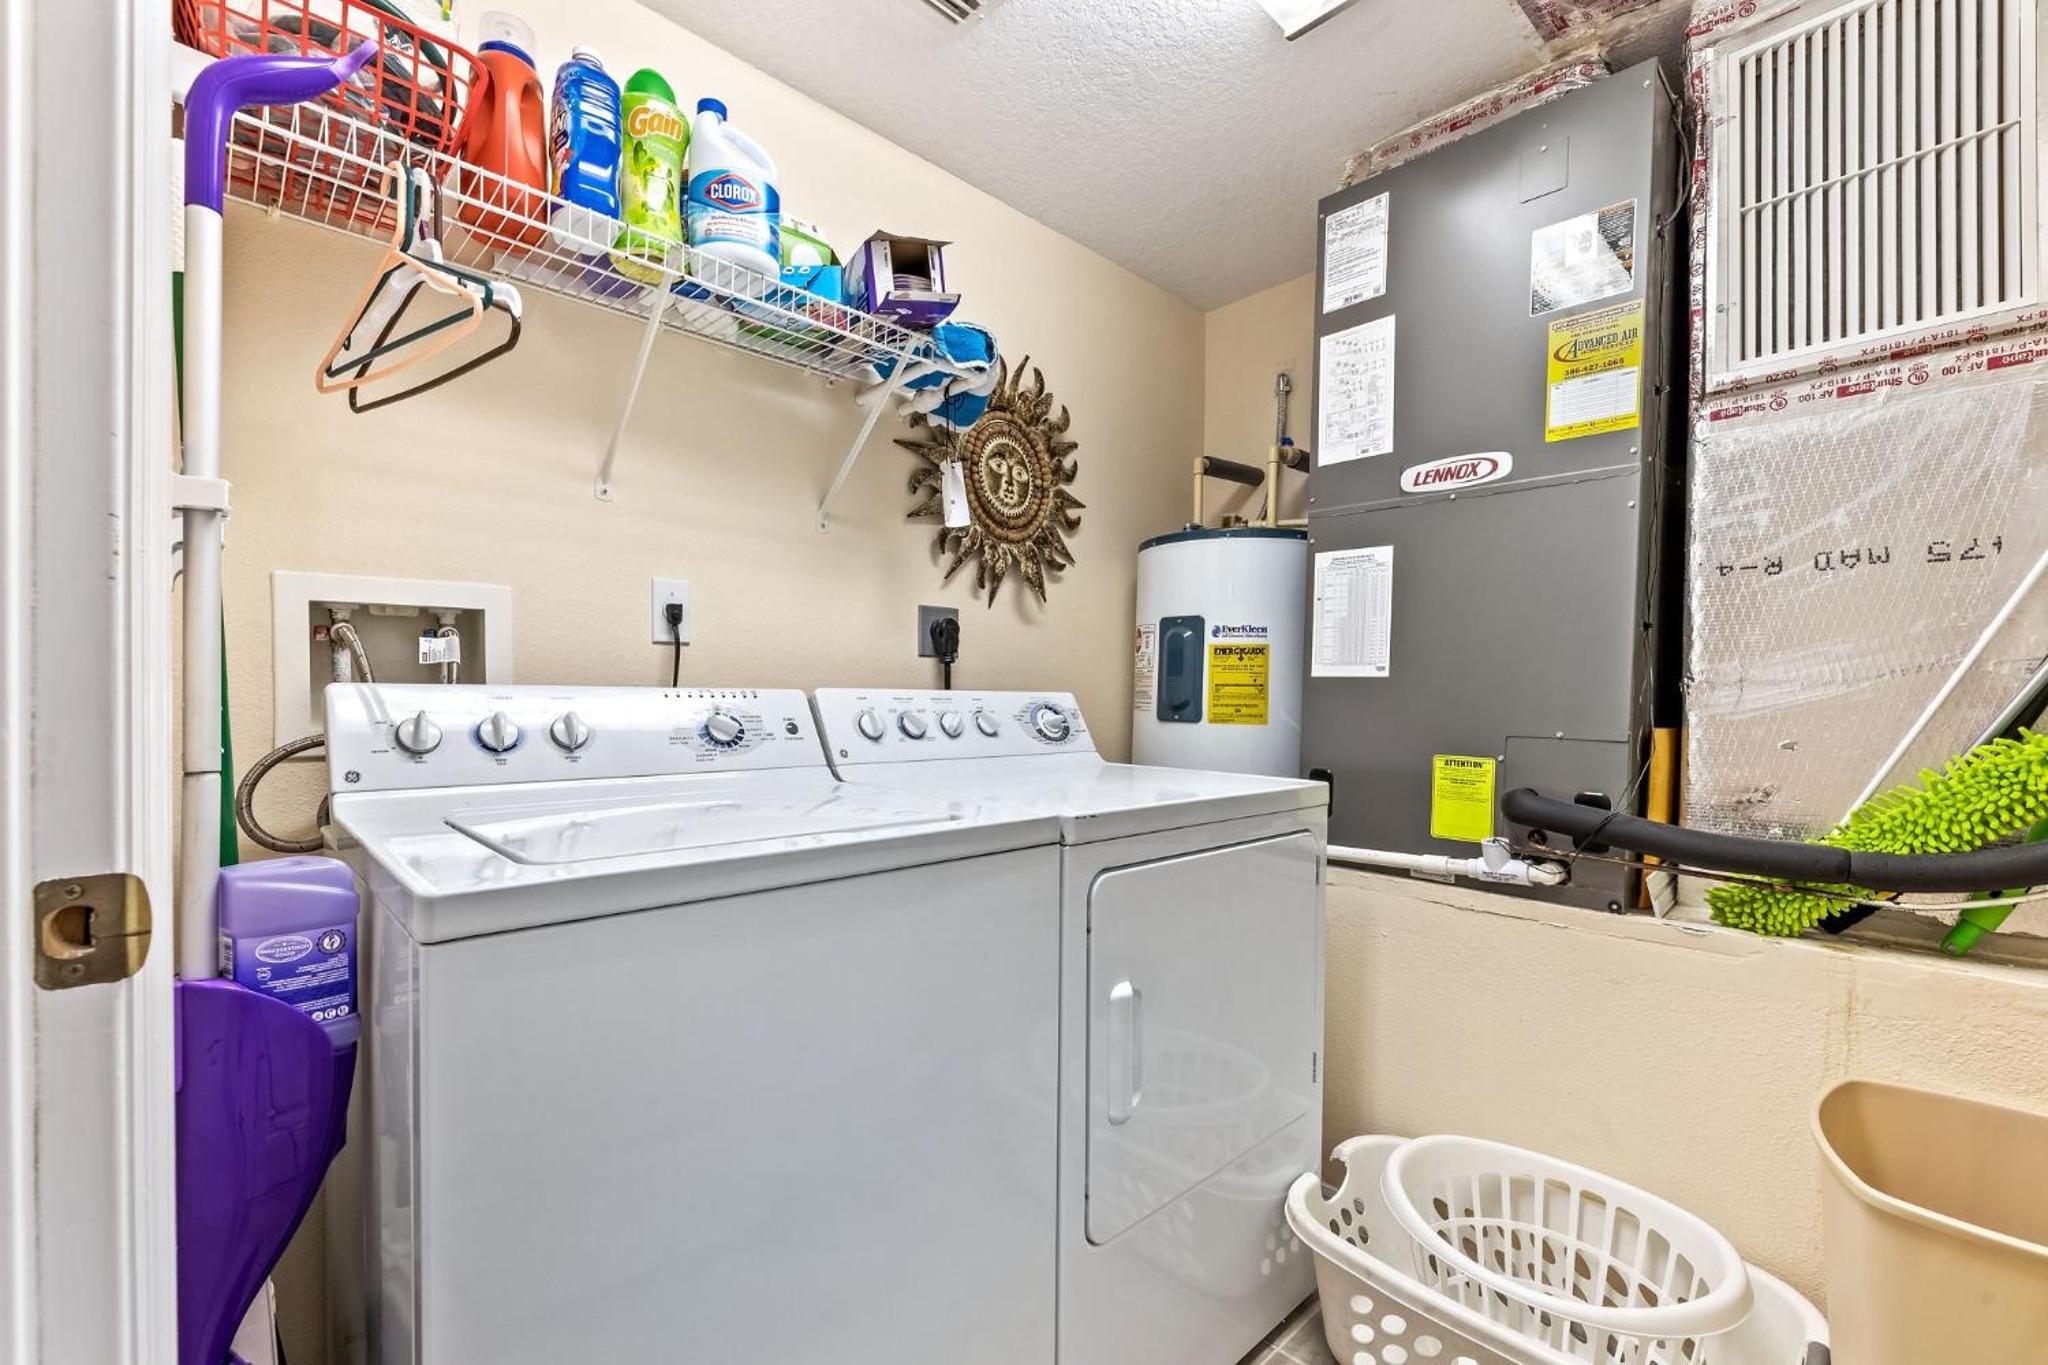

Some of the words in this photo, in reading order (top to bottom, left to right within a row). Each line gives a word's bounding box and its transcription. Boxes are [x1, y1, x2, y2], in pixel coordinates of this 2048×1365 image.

[629, 106, 683, 141] Gain
[710, 183, 756, 204] CLOROX
[1621, 327, 1639, 341] AIR
[1942, 366, 1961, 376] 100
[1966, 361, 1985, 372] AF
[1799, 394, 1816, 404] 100
[1819, 388, 1835, 399] AF
[1413, 461, 1482, 486] LENNOX
[1221, 625, 1268, 633] EverKleen
[1444, 759, 1483, 769] ATTENTION
